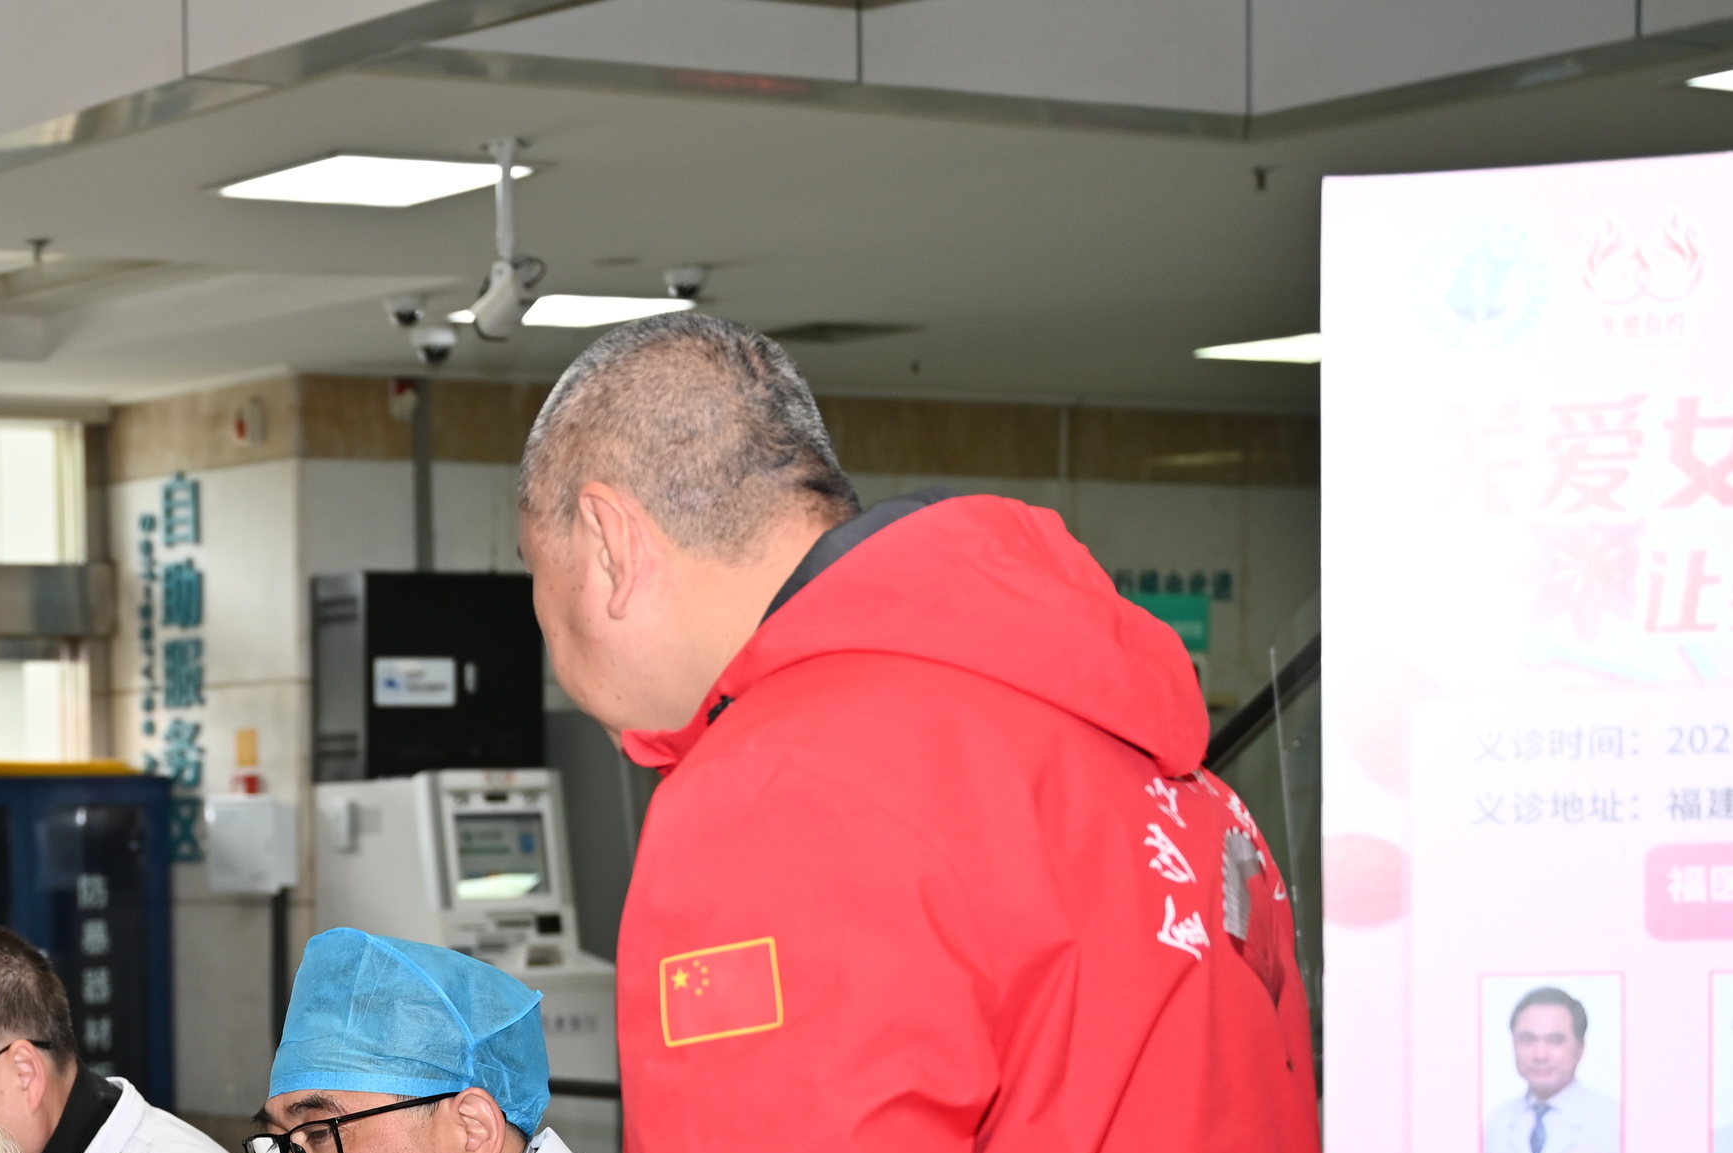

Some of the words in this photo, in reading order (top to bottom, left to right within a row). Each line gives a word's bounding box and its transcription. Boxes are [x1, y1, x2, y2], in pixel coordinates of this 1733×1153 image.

[1645, 550, 1733, 634] 让
[76, 873, 114, 1077] 防暴器材
